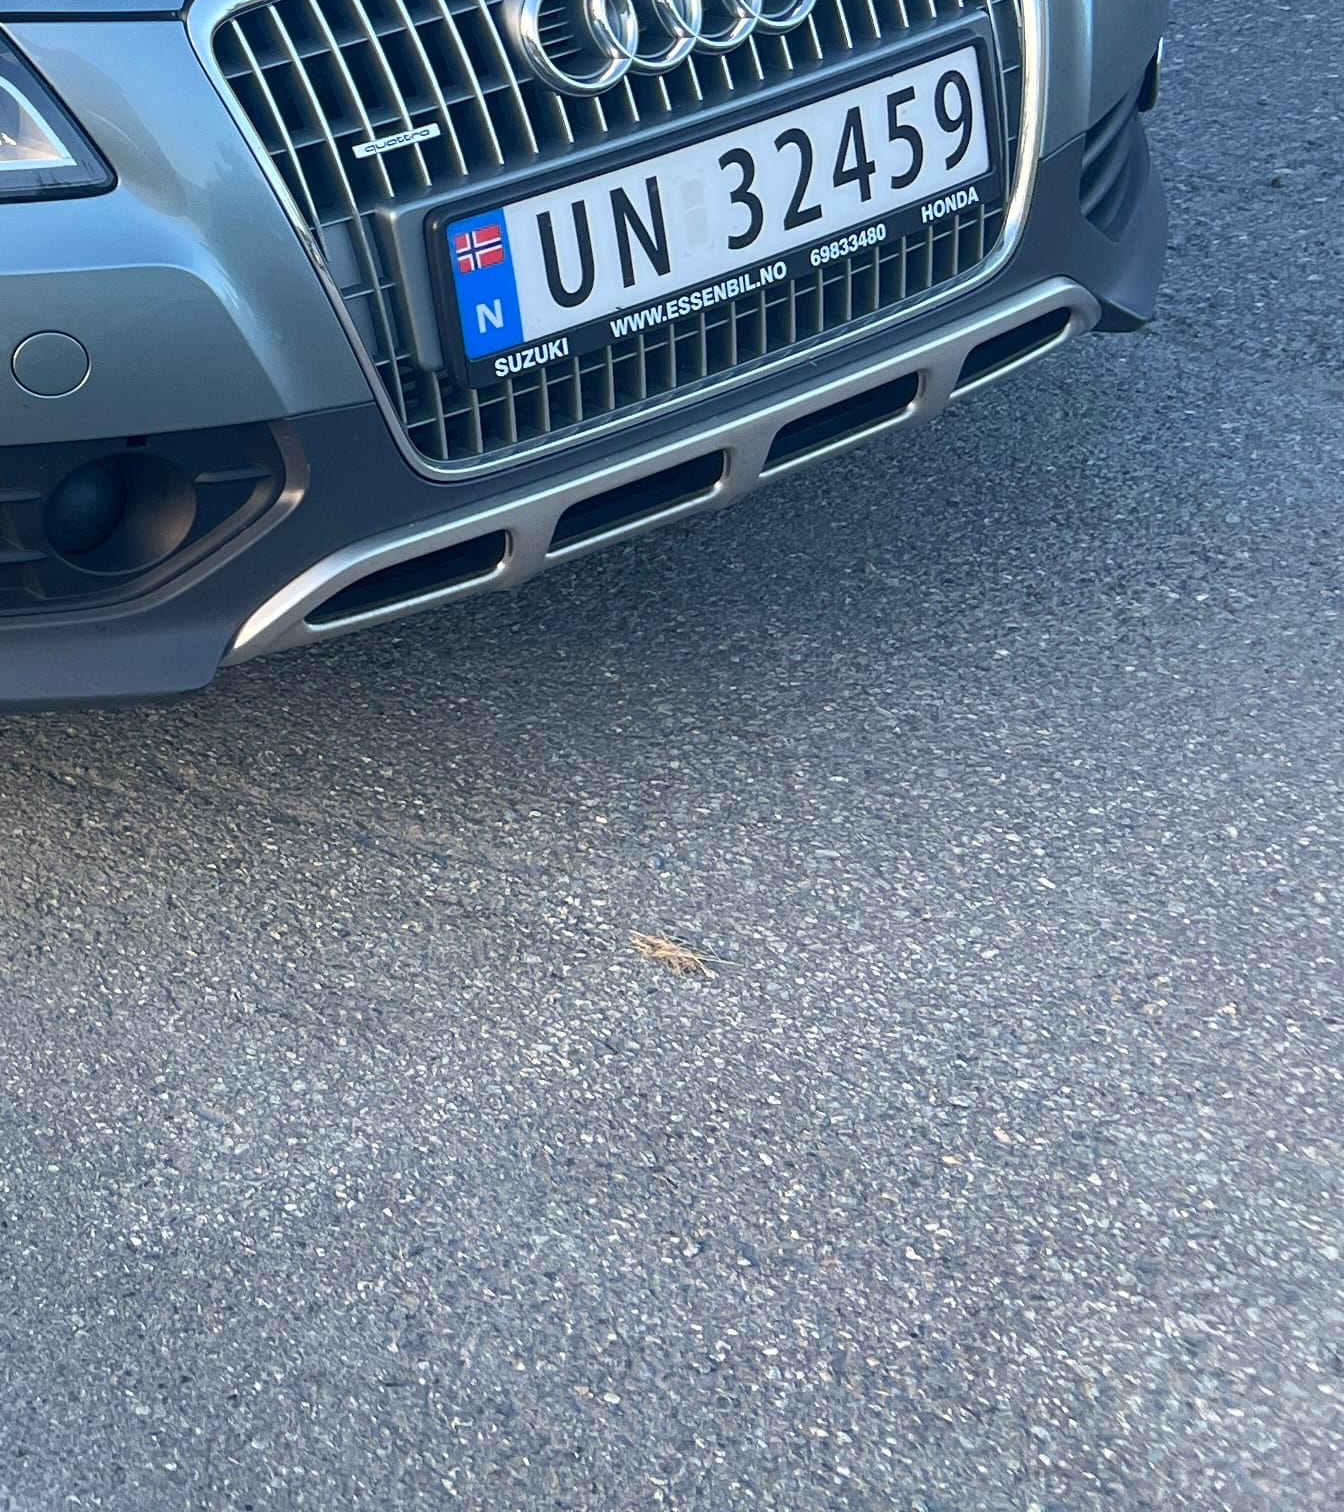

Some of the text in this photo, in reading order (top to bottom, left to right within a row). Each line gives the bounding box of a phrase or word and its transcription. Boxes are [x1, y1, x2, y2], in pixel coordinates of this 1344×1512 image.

[363, 128, 431, 153] quattro
[535, 69, 973, 309] UN 32459
[475, 298, 505, 334] N
[494, 186, 980, 378] SUZUKI WWW.ESSENBIL.NO 69833480 HONDA
